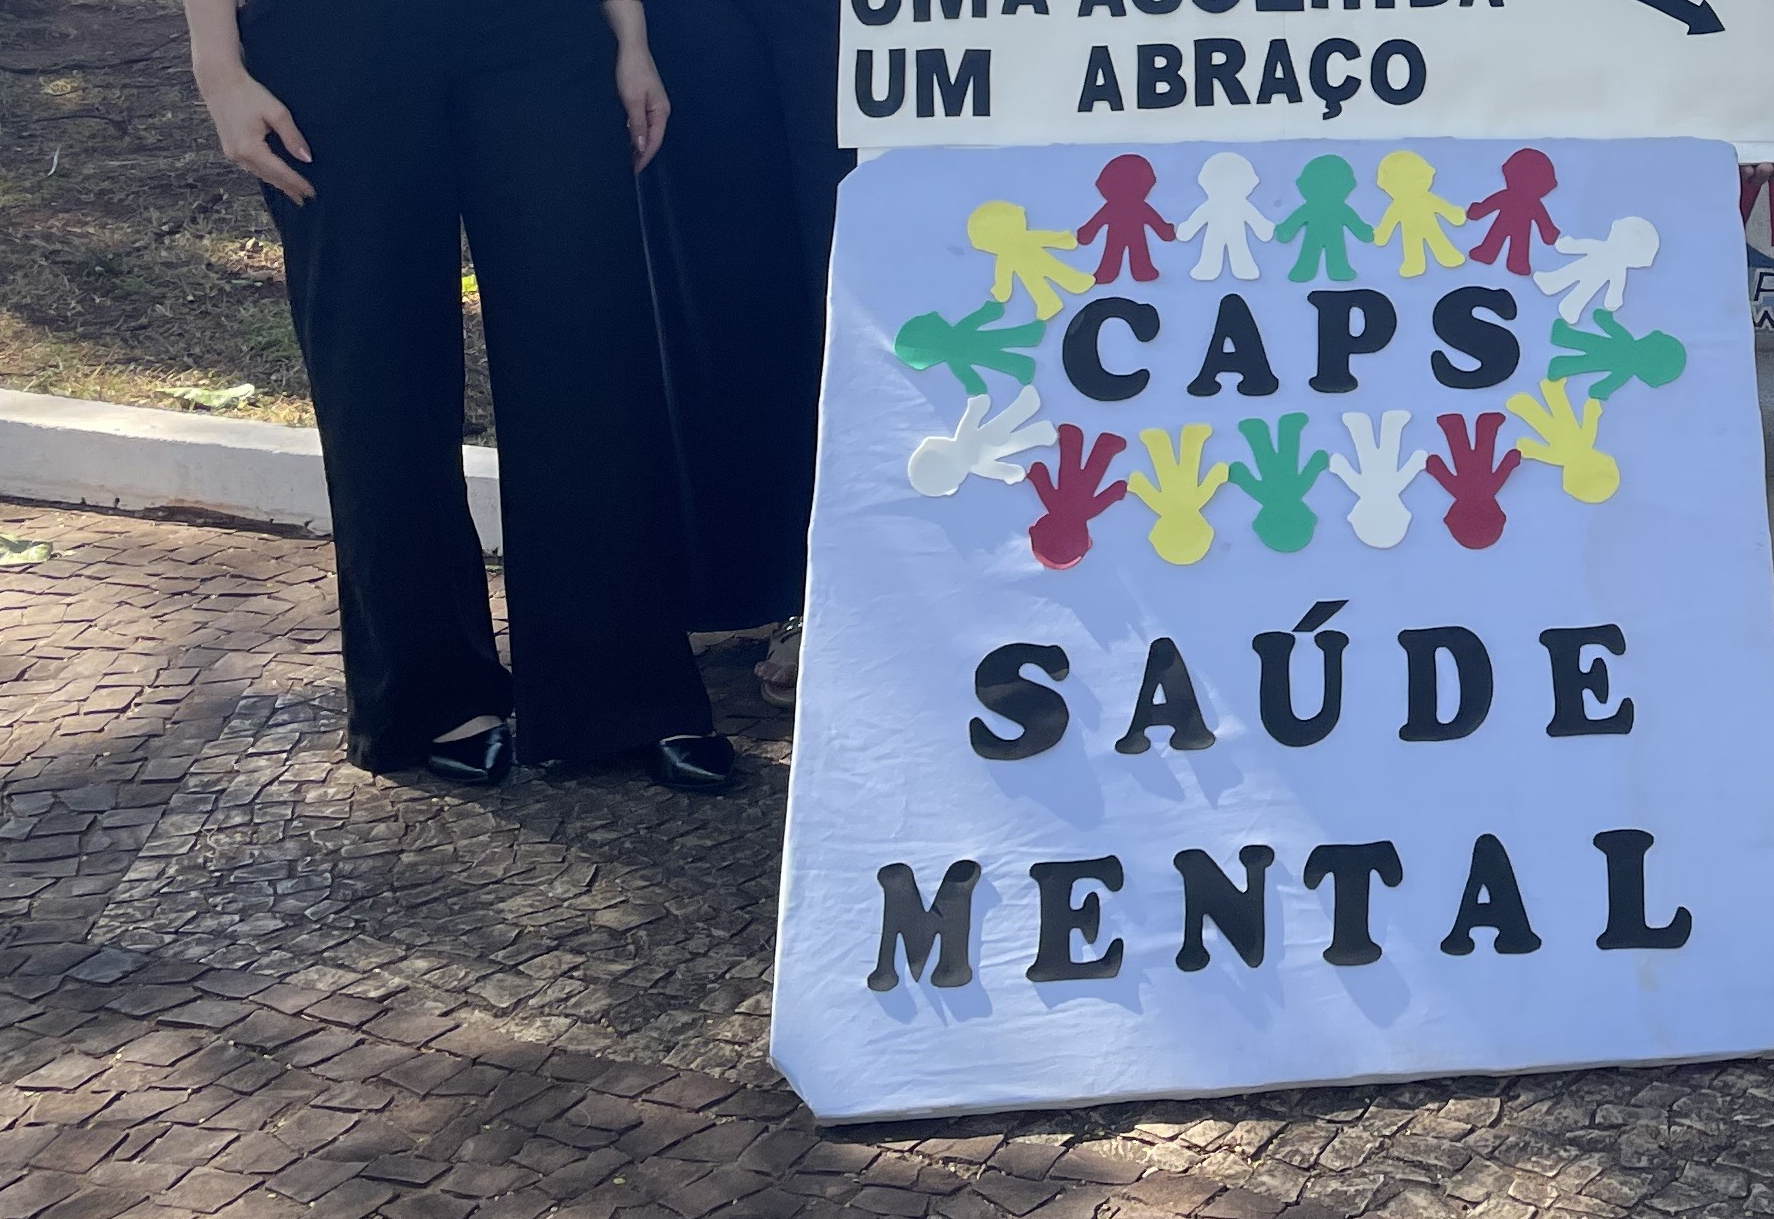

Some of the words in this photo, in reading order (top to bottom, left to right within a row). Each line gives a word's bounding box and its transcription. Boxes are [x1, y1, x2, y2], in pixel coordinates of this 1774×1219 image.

[855, 49, 990, 117] UM
[1078, 38, 1426, 120] ABRAÇO
[1062, 286, 1521, 401] CAPS
[970, 600, 1634, 760] SAÚDE
[868, 830, 1692, 991] MENTAL
